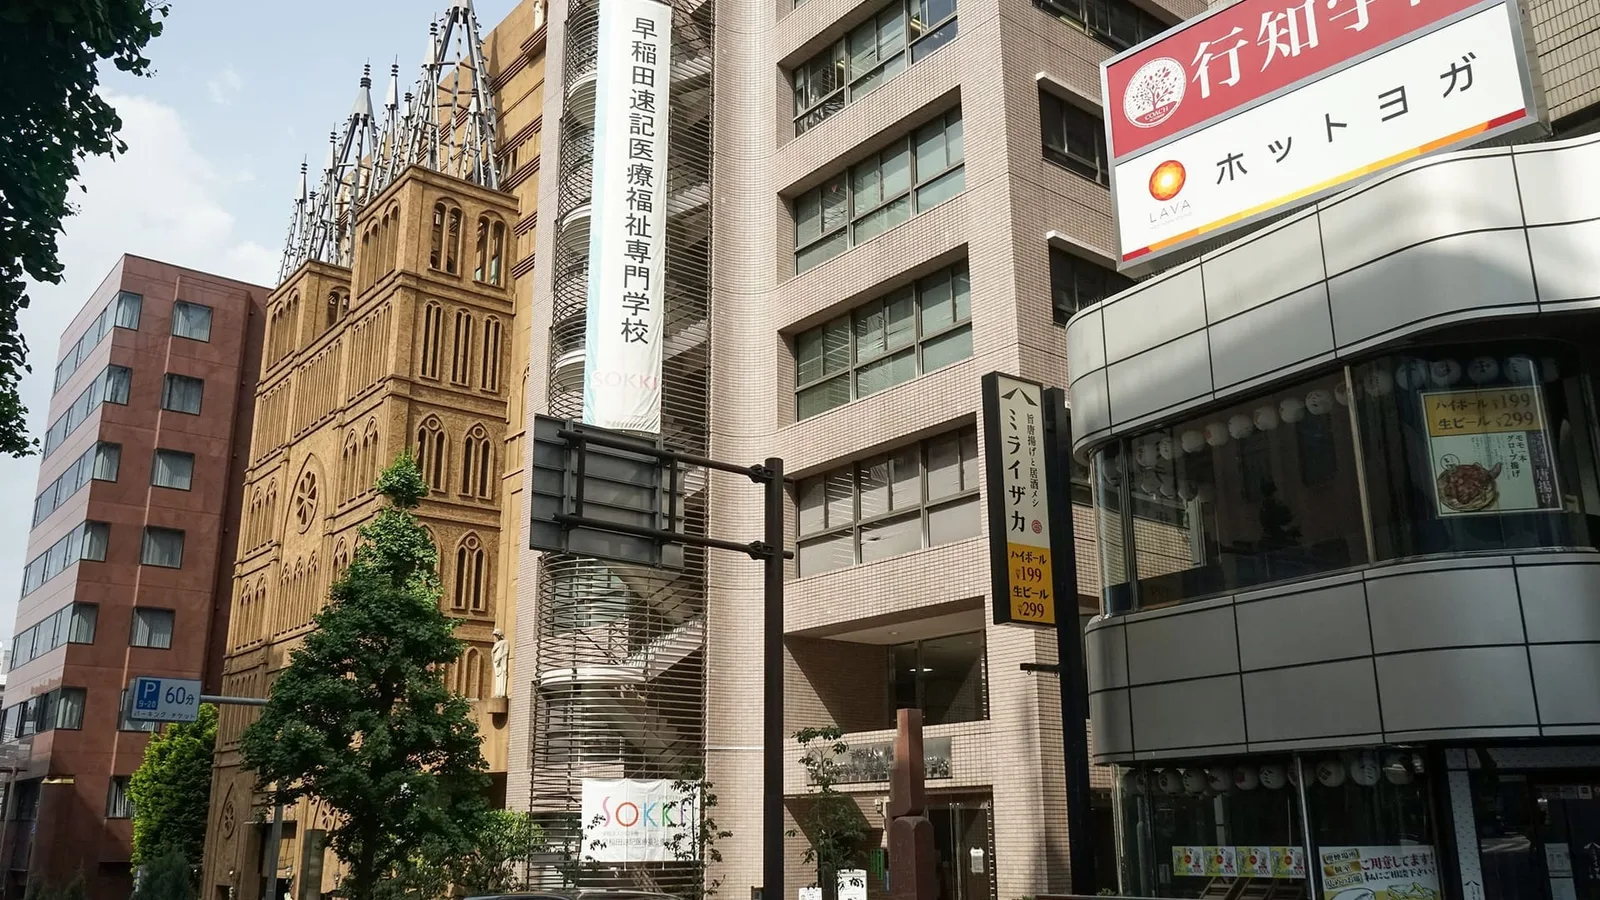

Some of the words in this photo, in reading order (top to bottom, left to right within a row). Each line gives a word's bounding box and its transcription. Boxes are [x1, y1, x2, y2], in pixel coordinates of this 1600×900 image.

[1216, 52, 1477, 185] ホットヨガ
[620, 16, 658, 345] 早稲田速記医療福祉専門学校
[1149, 199, 1192, 223] LAVA
[591, 371, 659, 392] SOKKI
[1436, 399, 1488, 412] ハイボール
[1438, 415, 1491, 431] 生ビール
[1026, 413, 1040, 508] 旨唐揚げと居酒メシ
[1006, 408, 1027, 533] ミライザカ
[1011, 550, 1047, 565] ハイボール
[1013, 585, 1049, 600] 生ビール
[145, 682, 157, 699] P
[165, 686, 195, 705] 60分
[139, 701, 157, 709] 9-20
[172, 712, 195, 720] チケット
